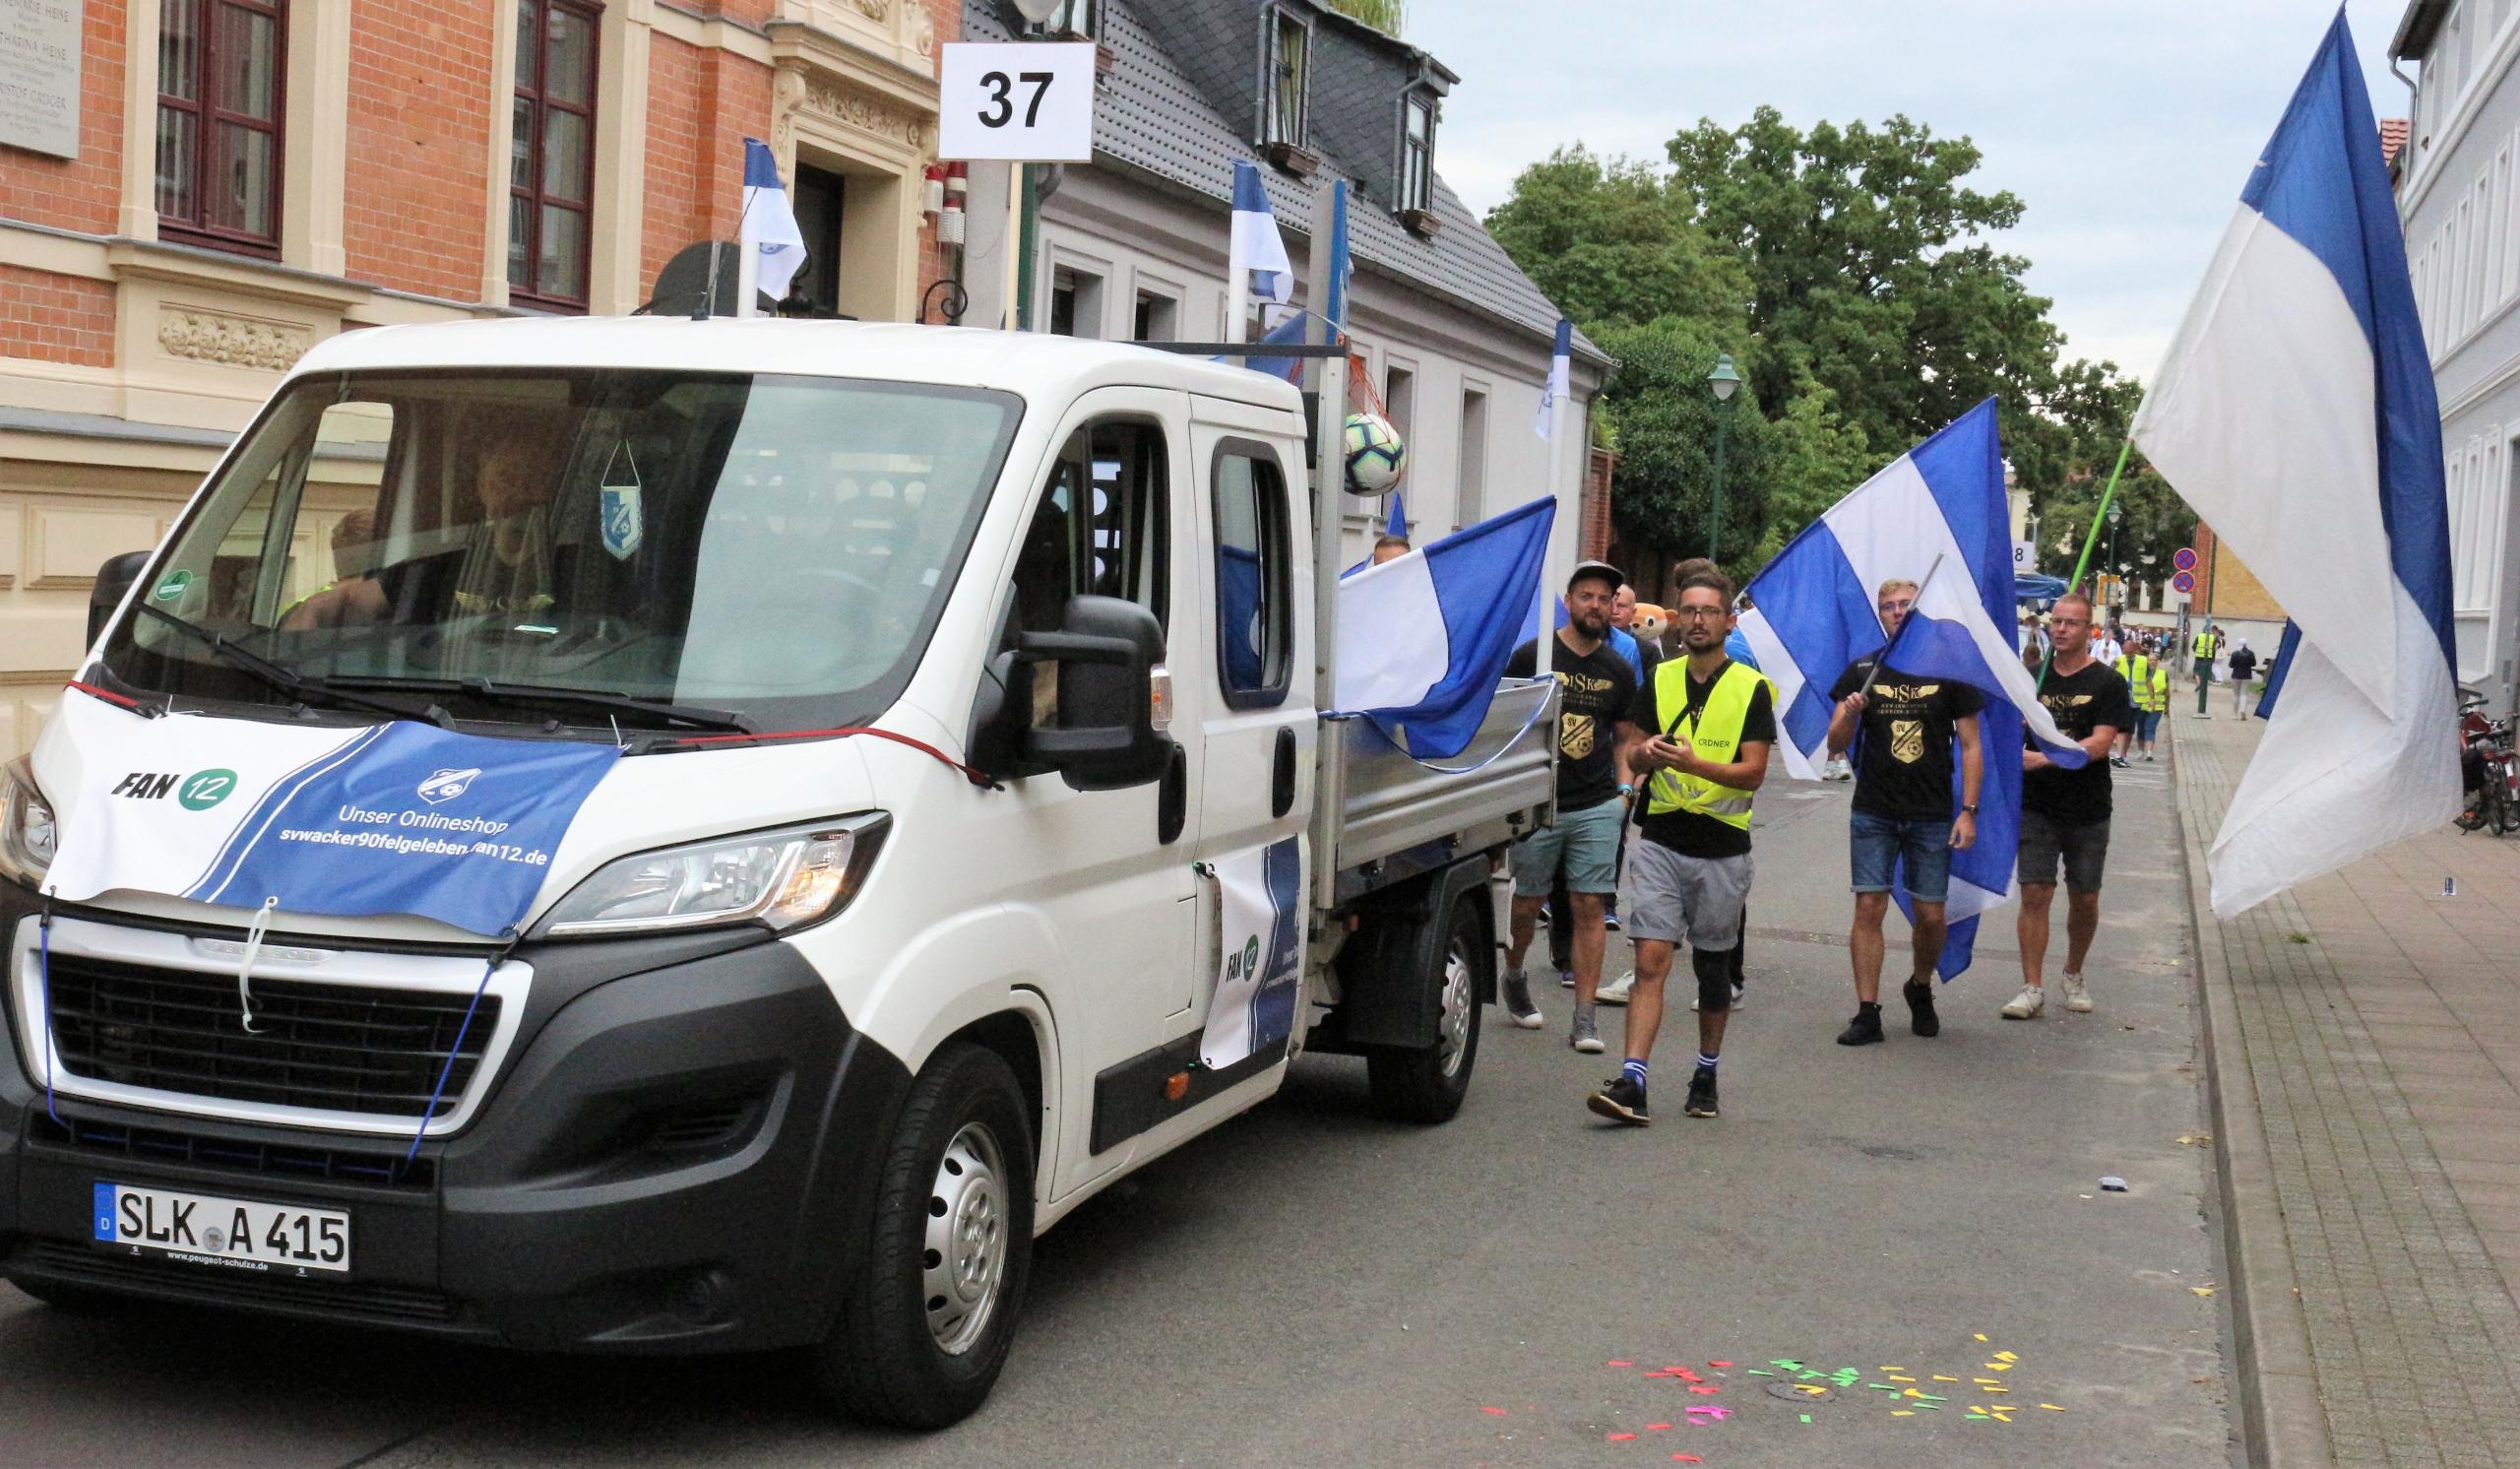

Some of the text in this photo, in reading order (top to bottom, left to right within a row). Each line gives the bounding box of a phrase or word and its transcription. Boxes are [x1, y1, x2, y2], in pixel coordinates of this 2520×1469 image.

[977, 71, 1054, 129] 37
[1569, 672, 1598, 693] ISK
[1893, 684, 1920, 703] ISK
[1698, 738, 1731, 748] ORDNER
[111, 773, 230, 800] FAN 12
[339, 804, 509, 836] Unser Onlineshop
[1226, 949, 1243, 984] FAN
[1245, 945, 1257, 971] 12
[100, 1192, 346, 1263] D SLK A 415
[167, 1250, 269, 1272] www.peugeot-schulze.de
